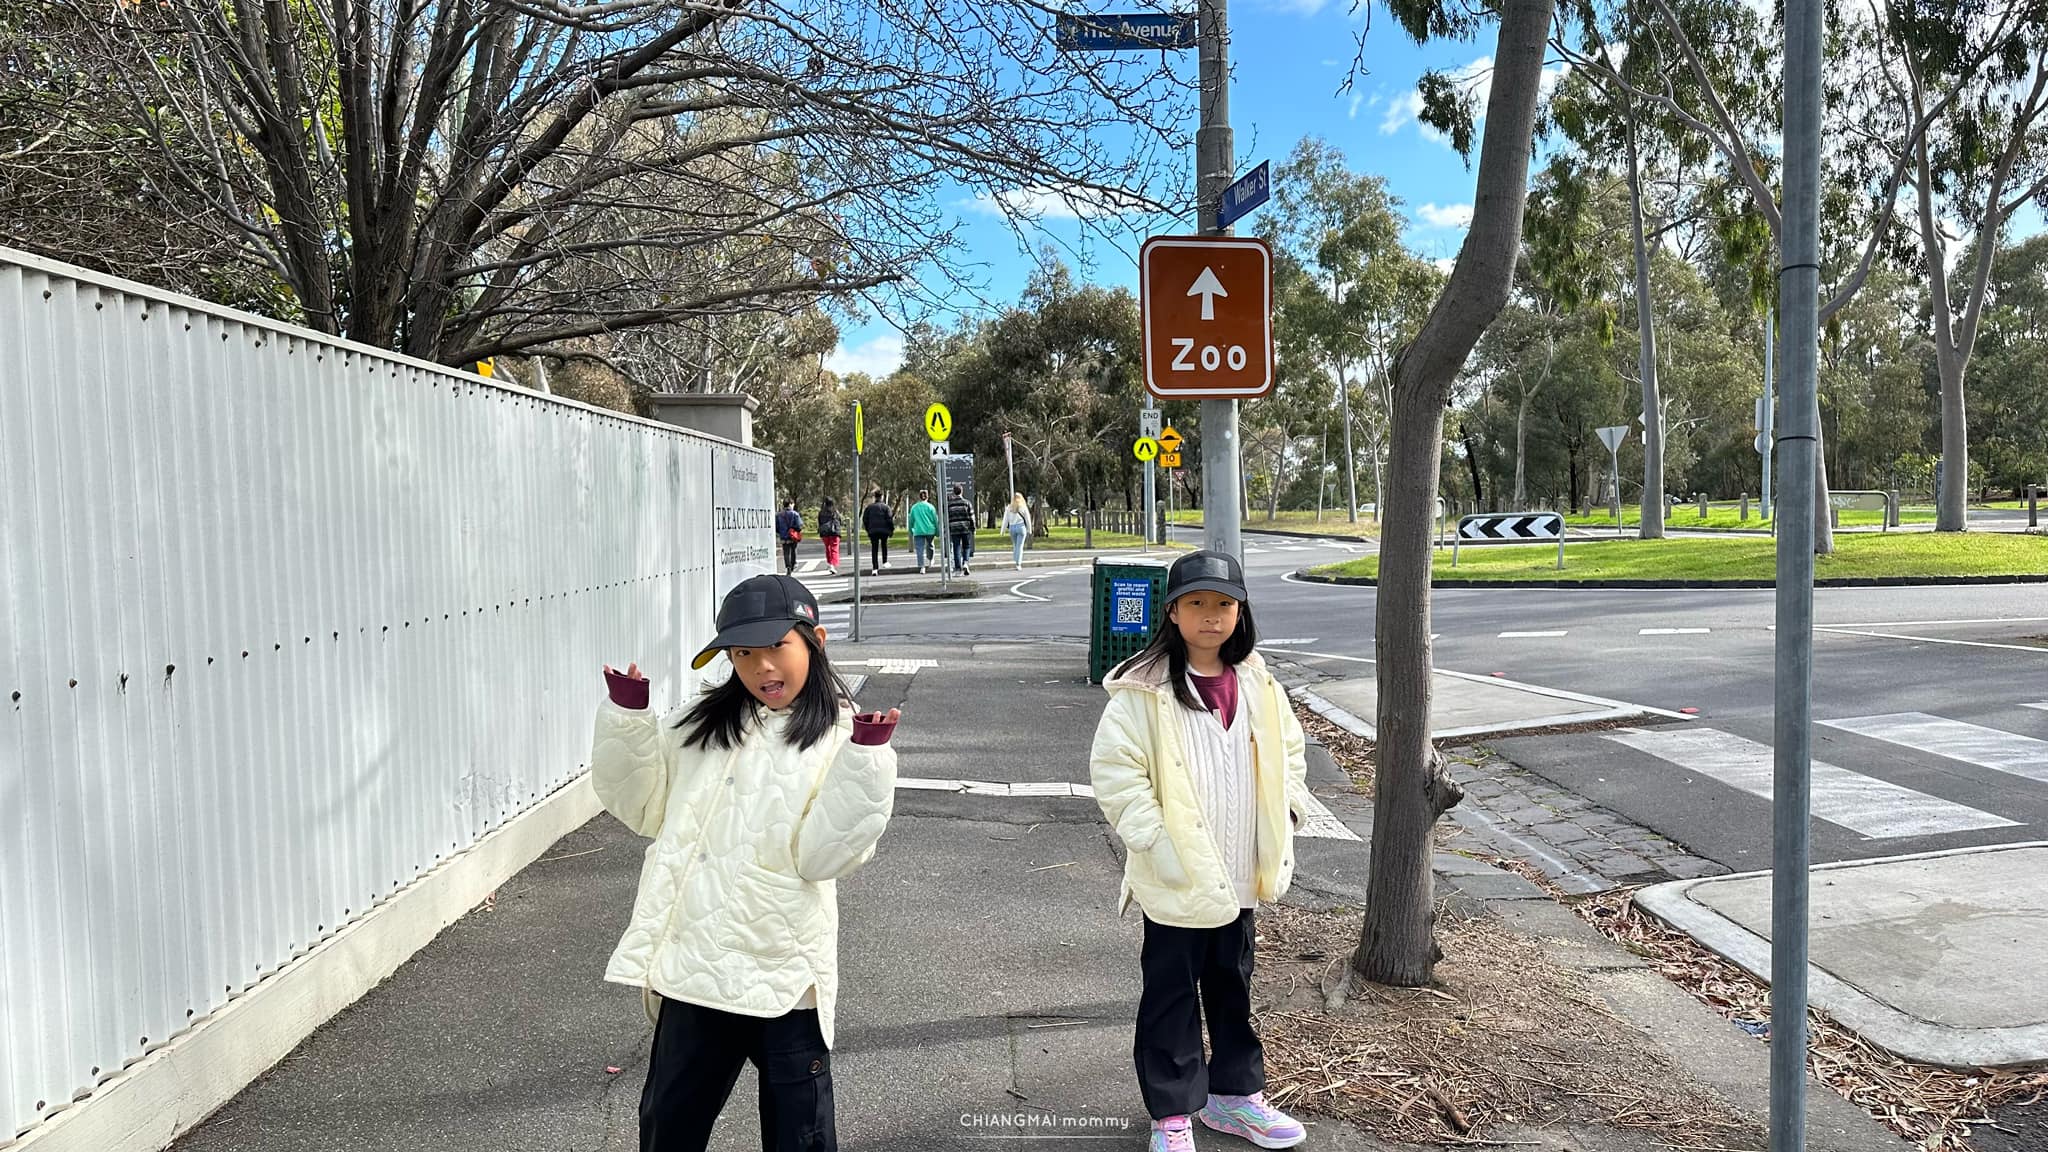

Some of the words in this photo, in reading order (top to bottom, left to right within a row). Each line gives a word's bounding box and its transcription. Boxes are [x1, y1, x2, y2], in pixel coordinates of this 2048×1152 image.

[1120, 21, 1181, 39] Avenue
[1233, 178, 1257, 206] Walker
[1258, 167, 1267, 190] St
[1171, 337, 1247, 371] Zoo
[1165, 454, 1175, 462] 10
[716, 507, 746, 530] TREACY
[746, 508, 771, 529] CENTRE
[721, 547, 746, 565] Conferences
[750, 546, 769, 563] Receptions
